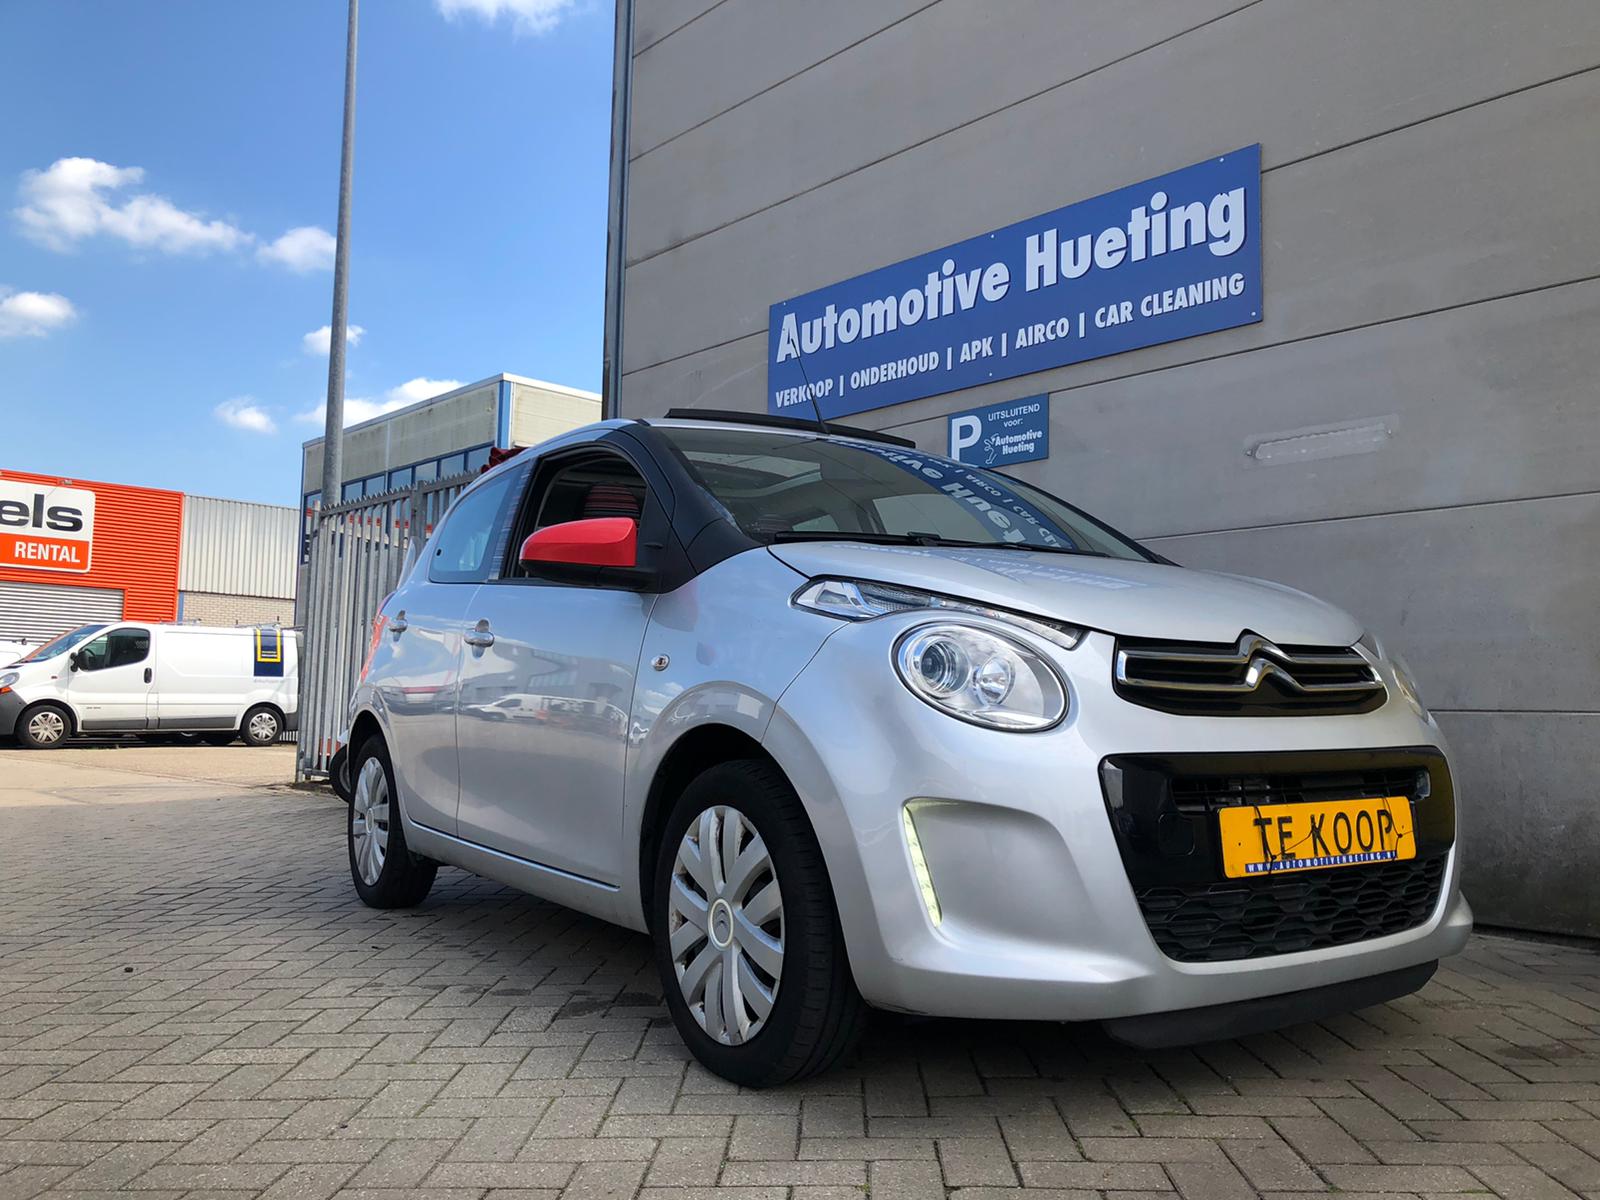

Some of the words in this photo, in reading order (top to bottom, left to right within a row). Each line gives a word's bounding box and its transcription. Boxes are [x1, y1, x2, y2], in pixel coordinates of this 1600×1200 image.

[776, 259, 1011, 363] Automotive
[1025, 187, 1246, 292] Hueting
[775, 378, 834, 408] VERKOOP
[850, 351, 940, 389] ONDERHOUD
[959, 336, 994, 363] APK
[1015, 317, 1070, 349] AIRCO
[1094, 301, 1134, 329] CAR
[1140, 273, 1245, 317] CLEANING
[988, 403, 1041, 421] UITSLUITEND
[1003, 418, 1024, 428] voor:
[995, 429, 1043, 446] Automotive
[1002, 441, 1035, 455] Hueting
[14, 541, 81, 563] RENTAL
[1253, 816, 1296, 860] TE
[1310, 809, 1393, 857] KOOP
